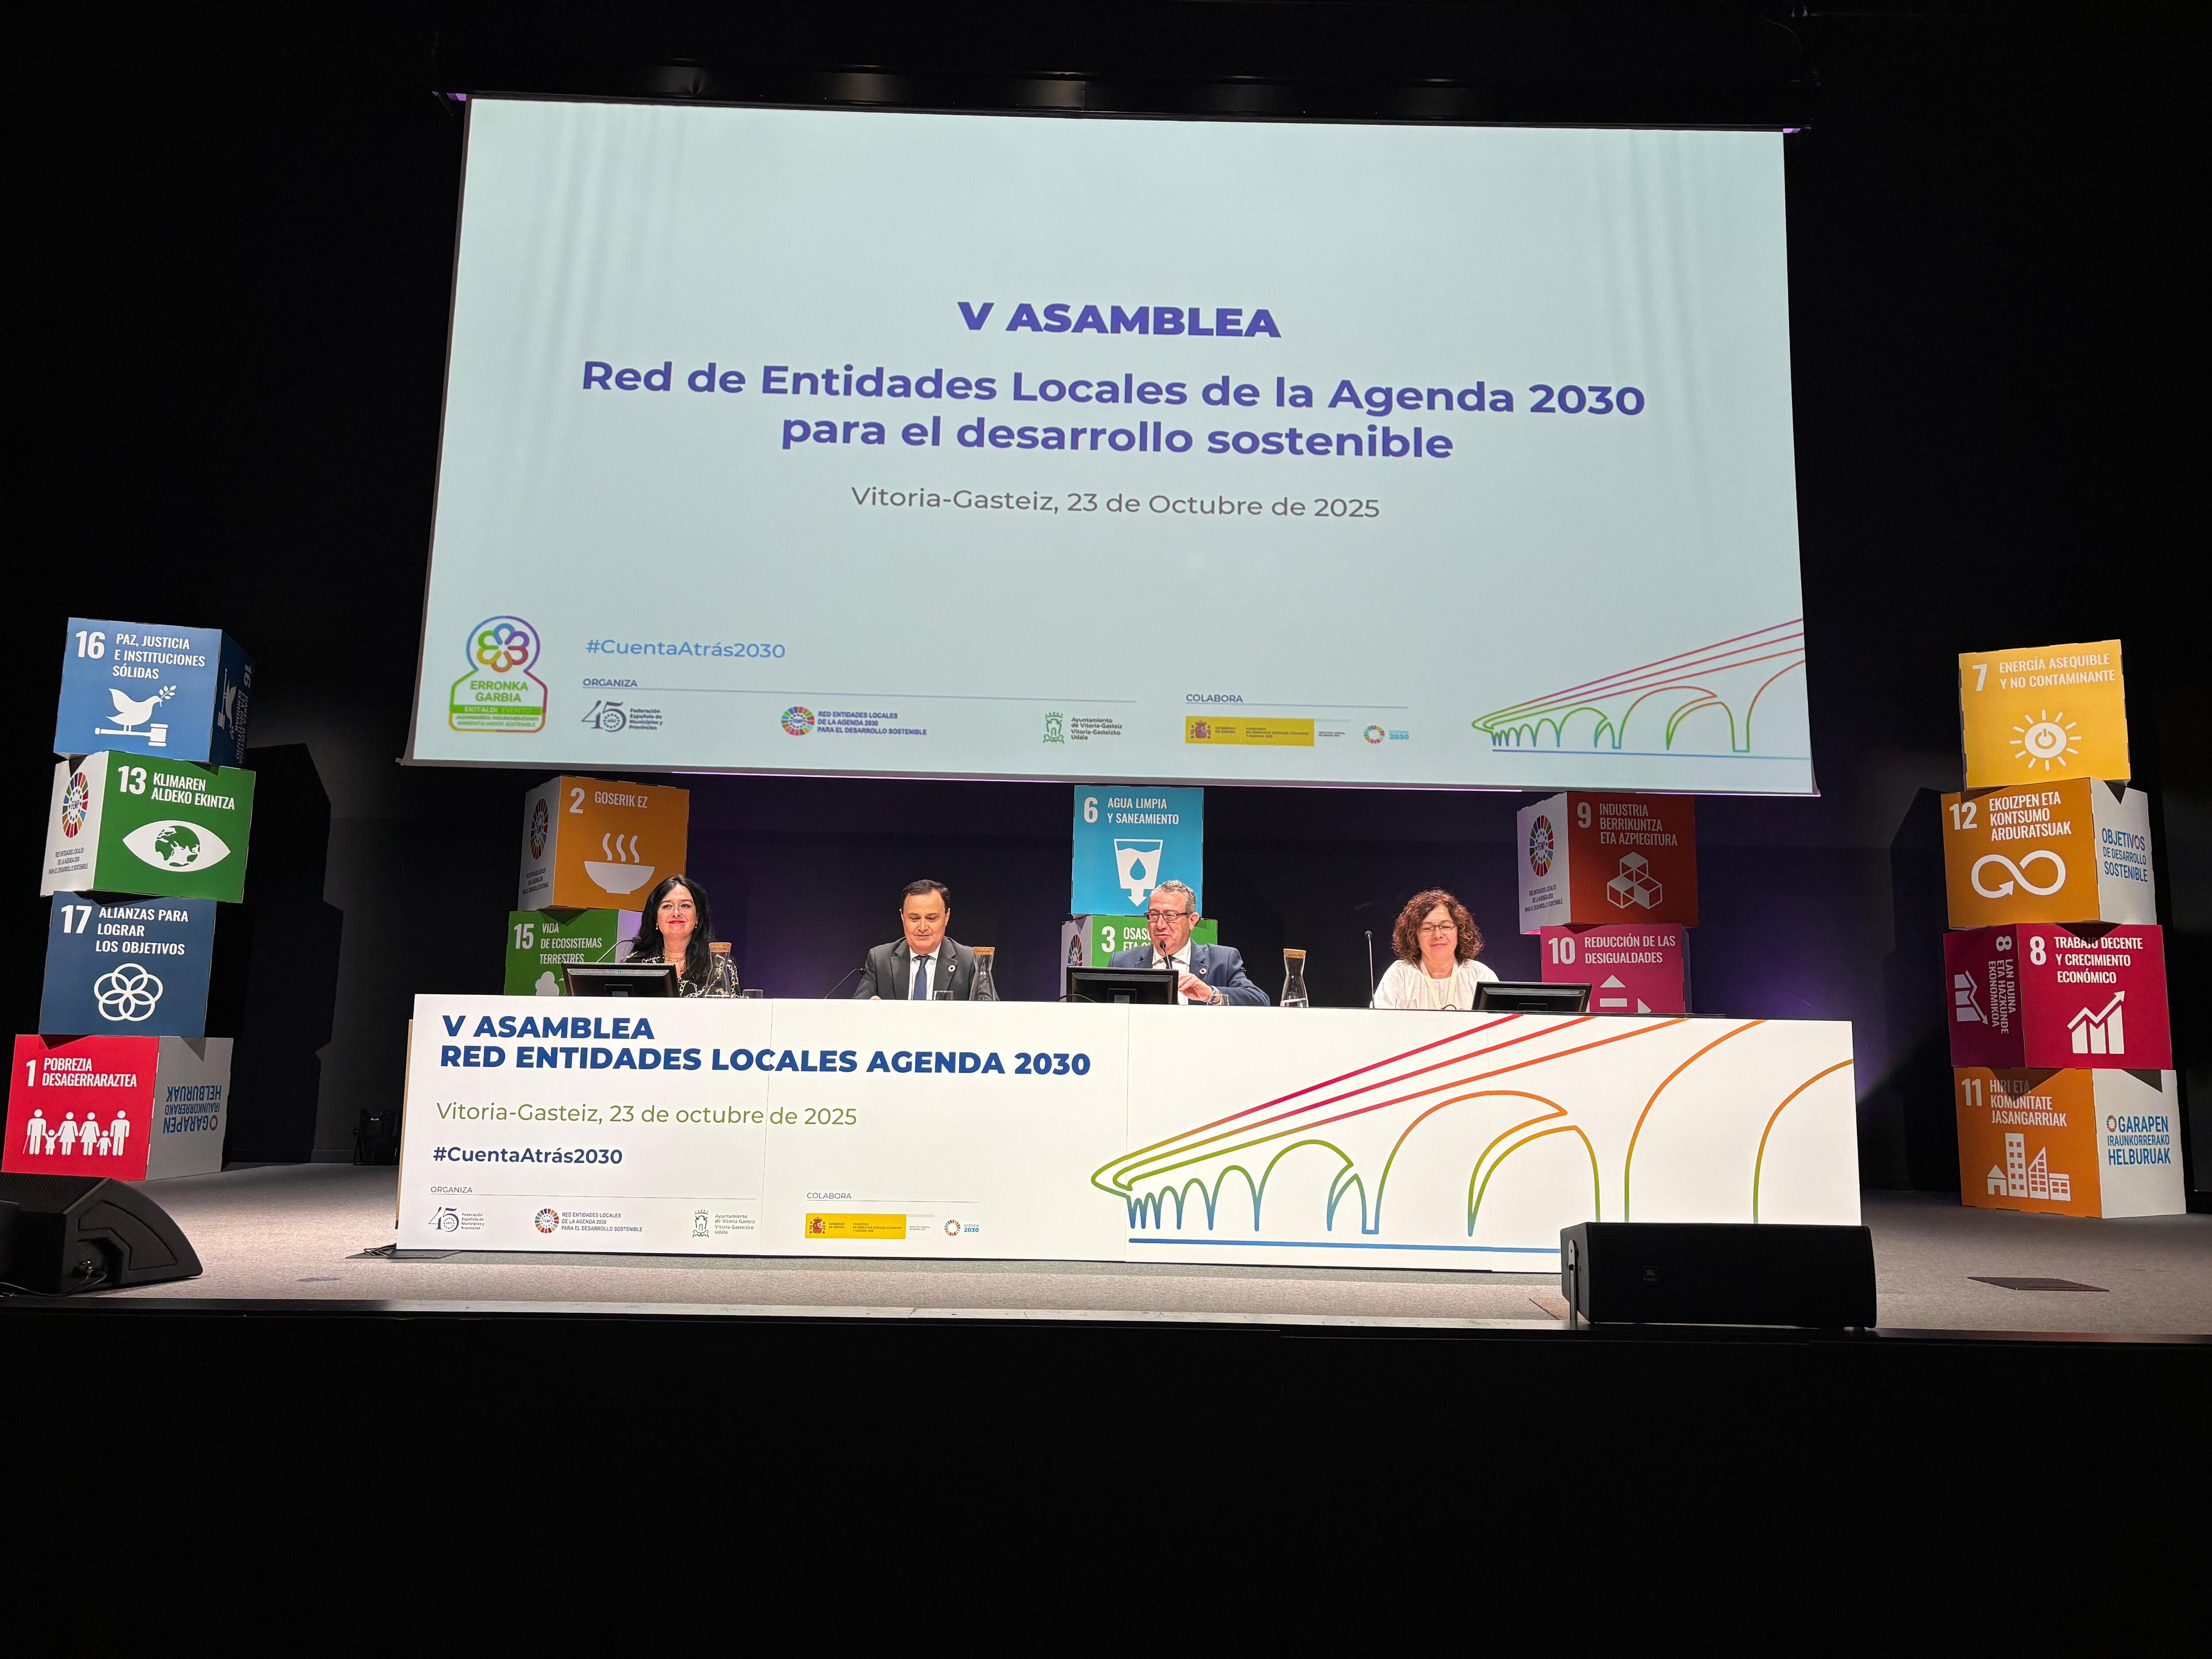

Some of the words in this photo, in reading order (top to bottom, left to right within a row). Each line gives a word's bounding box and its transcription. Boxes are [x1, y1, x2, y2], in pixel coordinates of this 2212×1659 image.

[958, 302, 994, 330] V
[1006, 303, 1281, 338] ASAMBLEA
[583, 361, 672, 391] Red
[688, 363, 745, 393] de
[762, 364, 996, 400] Entidades
[1014, 372, 1187, 405] Locales
[1202, 376, 1260, 406] de
[1277, 377, 1313, 407] la
[1328, 380, 1513, 417] Agenda
[1529, 384, 1644, 415] 2030
[783, 420, 885, 449] para
[902, 416, 941, 446] el
[957, 417, 1192, 453] desarrollo
[1208, 425, 1453, 458] sostenible
[851, 487, 1058, 514] Vitoria-Gasteiz,
[1068, 493, 1097, 511] 23
[1106, 494, 1140, 512] de
[1149, 495, 1262, 515] Octubre
[1272, 497, 1306, 515] de
[1314, 499, 1379, 517] 2025
[76, 631, 105, 658] 16
[116, 634, 138, 647] PAZ,
[142, 636, 190, 649] JUSTICIA
[586, 640, 786, 658] #CuentaAtrás2030
[115, 649, 121, 660] E
[124, 650, 205, 667] INSTITUCIONES
[1999, 657, 2047, 674] ENERGÍA
[2049, 653, 2109, 669] ASEQUIBLE
[113, 663, 159, 679] SÓLIDAS
[1973, 664, 1987, 691] 7
[2000, 679, 2007, 689] Y
[2010, 677, 2026, 688] NO
[2029, 669, 2115, 687] CONTAMINANTE
[470, 680, 528, 691] ERRONKA
[476, 692, 521, 702] GARBIA
[1186, 694, 1243, 703] COLABORA
[118, 766, 146, 794] 13
[154, 772, 206, 791] KLIMAREN
[151, 787, 192, 804] ALDEKO
[195, 793, 234, 810] EKINTZA
[570, 788, 585, 814] 2
[595, 791, 635, 806] GOSERIK
[637, 796, 648, 808] EZ
[1108, 798, 1133, 808] AGUA
[1136, 799, 1167, 809] LIMPIA
[1989, 793, 2039, 811] EKOIZPEN
[2042, 791, 2061, 805] ETA
[1084, 797, 1098, 823] 6
[1108, 813, 1113, 823] Y
[1116, 813, 1179, 824] SANEAMIENTO
[1577, 802, 1592, 828] 9
[1600, 803, 1648, 816] INDUSTRIA
[1949, 802, 1978, 830] 12
[1989, 808, 2050, 826] KONTSUMO
[1600, 817, 1663, 831] BERRIKUNTZA
[1992, 821, 2071, 841] ARDURATSUAK
[1601, 832, 1616, 844] ETA
[1619, 833, 1678, 846] AZPIEGITURA
[2102, 827, 2145, 852] OBJETIVOS
[2103, 846, 2110, 857] DE
[2112, 847, 2147, 865] DESARROLLO
[2104, 860, 2148, 883] SOSTENIBLE
[61, 905, 92, 933] 17
[99, 907, 154, 920] ALIANZAS
[158, 910, 188, 922] PARA
[98, 923, 144, 937] LOGRAR
[514, 924, 534, 949] 15
[542, 922, 559, 933] VIDA
[96, 941, 118, 952] LOS
[122, 941, 184, 955] OBJETIVOS
[541, 939, 550, 949] DE
[552, 937, 602, 949] ECOSISTEMAS
[1102, 926, 1115, 952] 3
[1585, 933, 1640, 947] REDUCCIÓN
[1643, 936, 1655, 947] DE
[1658, 936, 1675, 946] LAS
[1996, 936, 2012, 951] 8
[2054, 937, 2098, 949] TRABAJO
[2101, 937, 2143, 949] DECENTE
[539, 953, 584, 964] TERRESTRES
[1548, 937, 1575, 964] 10
[1586, 952, 1663, 964] DESIGUALDADES
[2030, 936, 2046, 965] 8
[2005, 959, 2014, 978] LAN
[2055, 954, 2062, 965] Y
[2065, 954, 2131, 966] CRECIMIENTO
[2057, 968, 2116, 983] ECONÓMICO
[1989, 961, 1999, 1027] EKONOMIKOA
[2007, 981, 2016, 1013] DUINA
[1998, 980, 2008, 1033] HAZKUNDE
[442, 1015, 466, 1037] V
[473, 1016, 654, 1039] ASAMBLEA
[44, 1058, 92, 1071] POBREZIA
[441, 1045, 505, 1067] RED
[516, 1047, 701, 1070] ENTIDADES
[712, 1049, 857, 1072] LOCALES
[866, 1051, 1005, 1074] AGENDA
[1015, 1052, 1090, 1075] 2030
[26, 1060, 36, 1087] 1
[42, 1073, 137, 1087] DESAGERRARAZTEA
[166, 1085, 221, 1102] HELBURUAK
[1962, 1079, 1982, 1106] 11
[1990, 1079, 2010, 1093] HIRI
[165, 1103, 219, 1115] IRAUNKORRERAKO
[1991, 1095, 2053, 1110] KOMUNITATE
[437, 1102, 602, 1125] Vitoria-Gasteiz,
[610, 1106, 634, 1122] 23
[641, 1105, 668, 1122] de
[676, 1106, 763, 1123] octubre
[770, 1107, 797, 1124] de
[805, 1108, 856, 1125] 2025
[1992, 1111, 2067, 1126] JASANGARRIAK
[163, 1115, 208, 1133] GARAPEN
[2119, 1116, 2168, 1133] GARAPEN
[2108, 1135, 2170, 1146] IRAUNKORRERAKO
[433, 1147, 622, 1164] #CuentaAtrás2030
[2108, 1148, 2171, 1165] HELBURUAK
